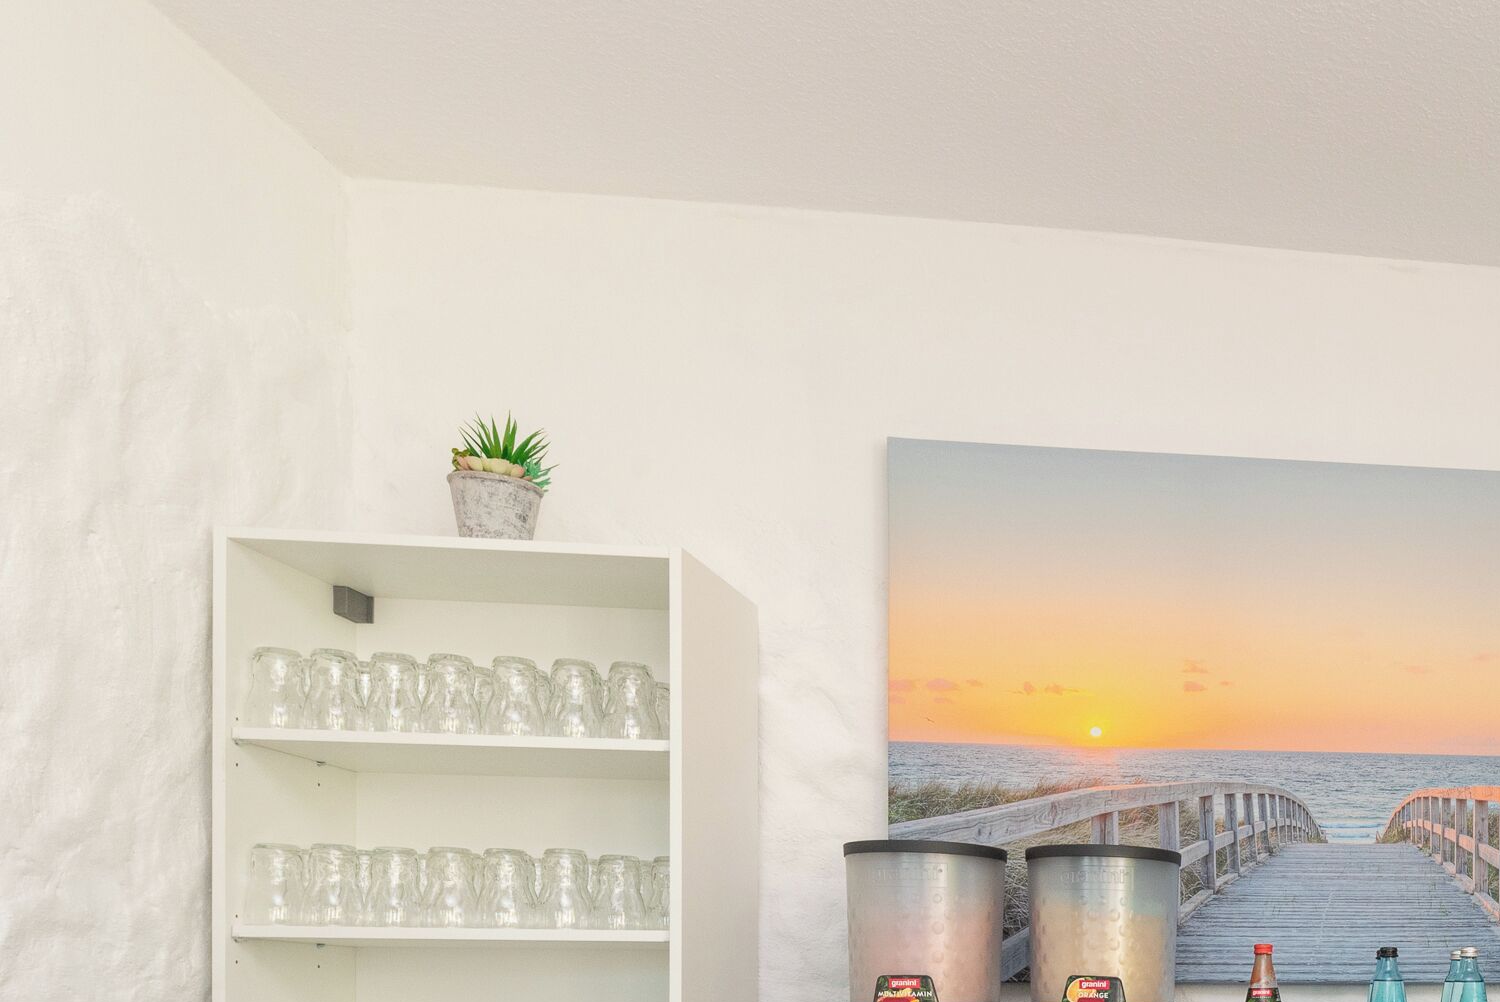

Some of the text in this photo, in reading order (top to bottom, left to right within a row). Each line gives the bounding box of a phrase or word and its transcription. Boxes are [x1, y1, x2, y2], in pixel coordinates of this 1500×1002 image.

[891, 979, 917, 987] granini
[1081, 980, 1107, 989] granini
[877, 990, 933, 998] MULTIVITAMIN
